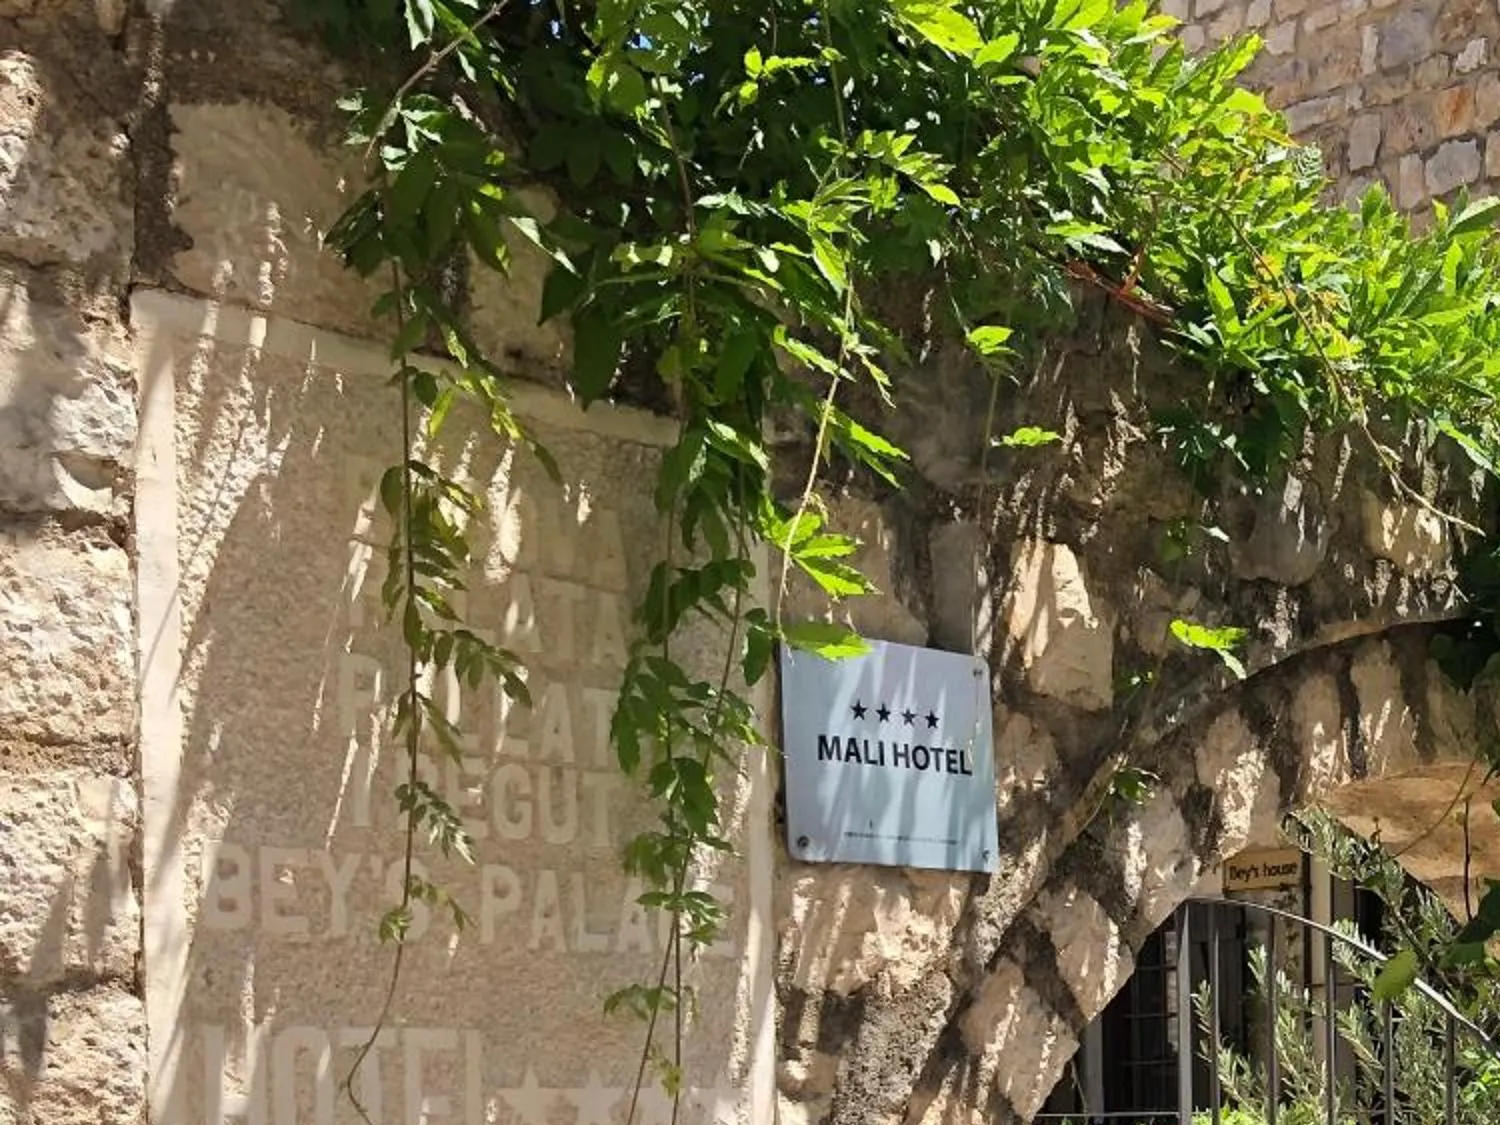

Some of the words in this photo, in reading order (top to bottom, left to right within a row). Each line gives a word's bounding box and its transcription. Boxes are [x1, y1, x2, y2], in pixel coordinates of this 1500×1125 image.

[817, 734, 885, 766] MALI
[894, 742, 973, 775] HOTEL
[204, 843, 430, 940] BEY'S
